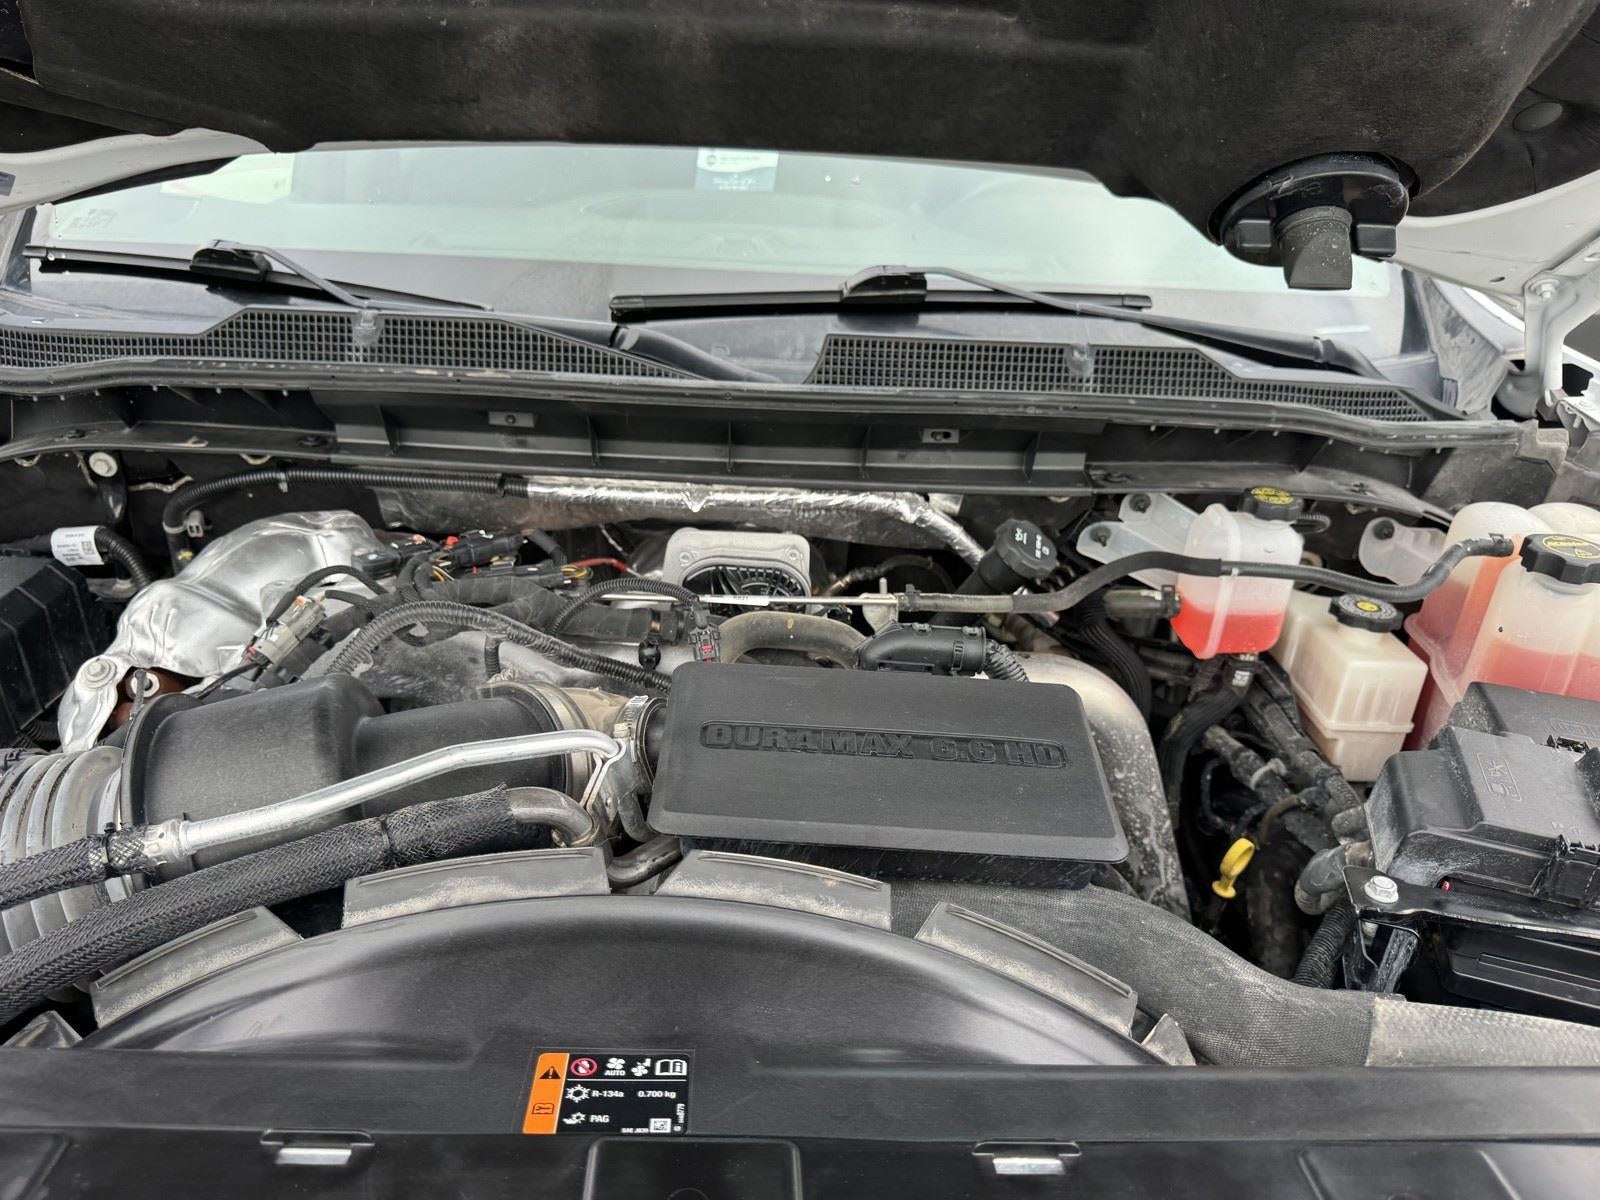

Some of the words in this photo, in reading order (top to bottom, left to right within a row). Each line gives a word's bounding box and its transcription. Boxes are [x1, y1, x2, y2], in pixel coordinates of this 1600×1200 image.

[705, 724, 914, 758] DURAMAX
[929, 736, 997, 764] 6.6
[1003, 741, 1067, 769] HD
[591, 1090, 624, 1098] R-134a
[637, 1090, 663, 1098] 0.700
[664, 1090, 677, 1099] kg
[589, 1114, 610, 1123] PAG
